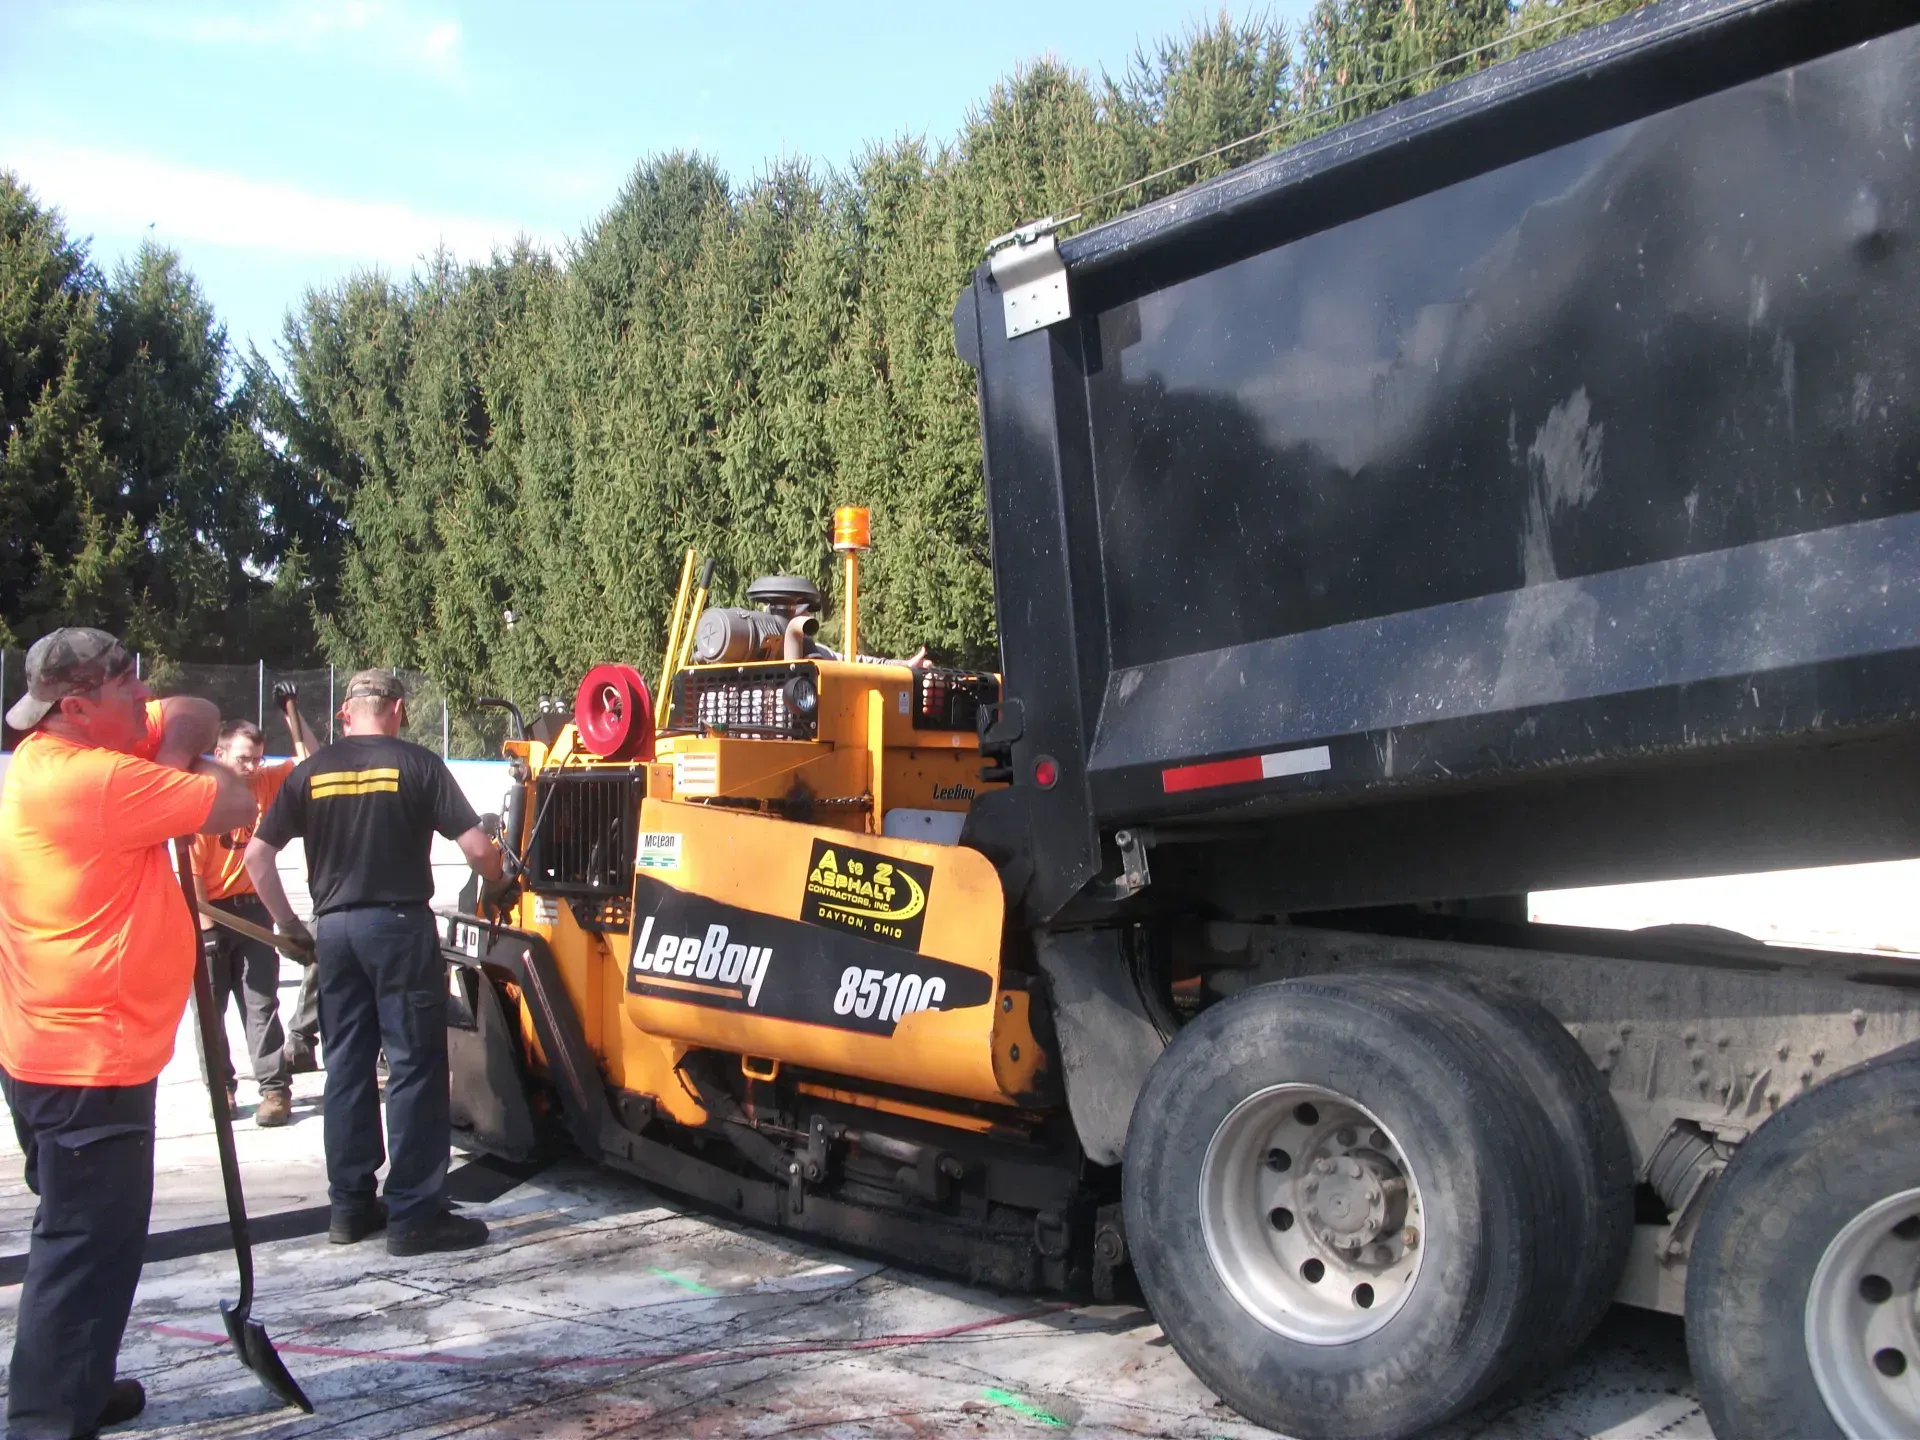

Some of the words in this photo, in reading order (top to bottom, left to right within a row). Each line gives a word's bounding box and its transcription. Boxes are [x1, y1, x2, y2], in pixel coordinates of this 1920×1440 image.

[932, 783, 976, 799] LeeBoy
[818, 849, 838, 873] A
[847, 858, 864, 876] to
[873, 862, 893, 886] Z
[807, 883, 872, 908] CONTRACTORS,
[874, 901, 892, 913] INC.
[809, 868, 896, 902] ASPHALT
[818, 907, 867, 931] DAYTON,
[873, 922, 902, 938] OHIO
[633, 915, 773, 1007] LeeBoy
